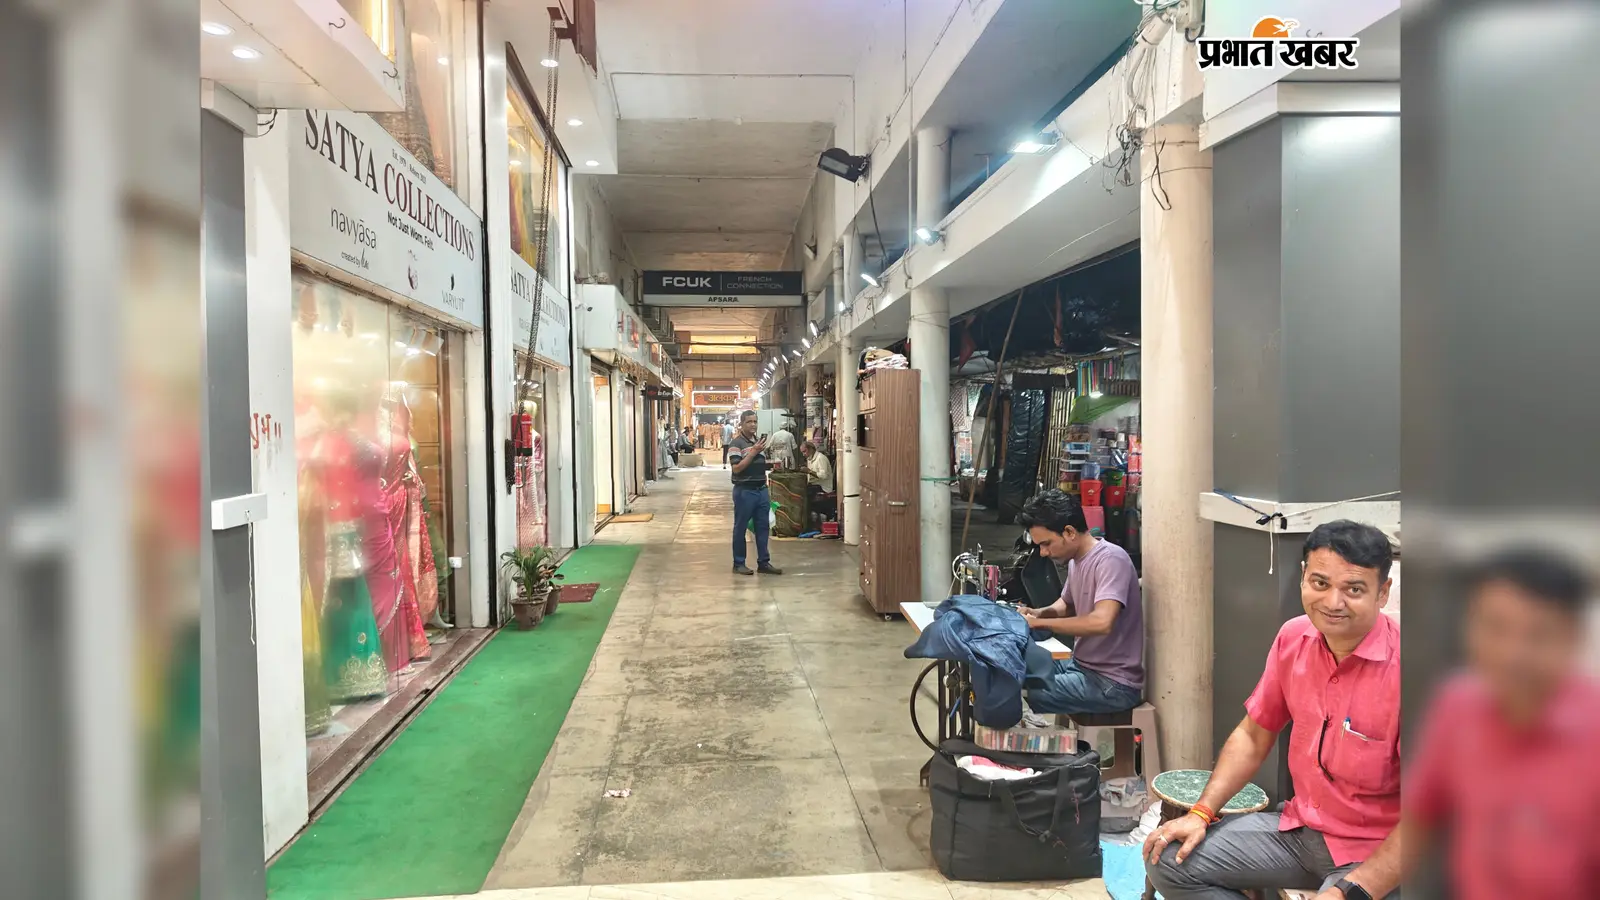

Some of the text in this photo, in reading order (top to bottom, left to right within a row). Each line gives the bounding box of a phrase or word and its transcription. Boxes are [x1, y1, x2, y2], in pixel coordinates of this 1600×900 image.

[305, 108, 475, 261] SATYA COLLECTIONS
[330, 207, 377, 249] navyāsa
[387, 211, 398, 228] Not
[398, 217, 410, 236] Just
[662, 276, 712, 288] FCUK
